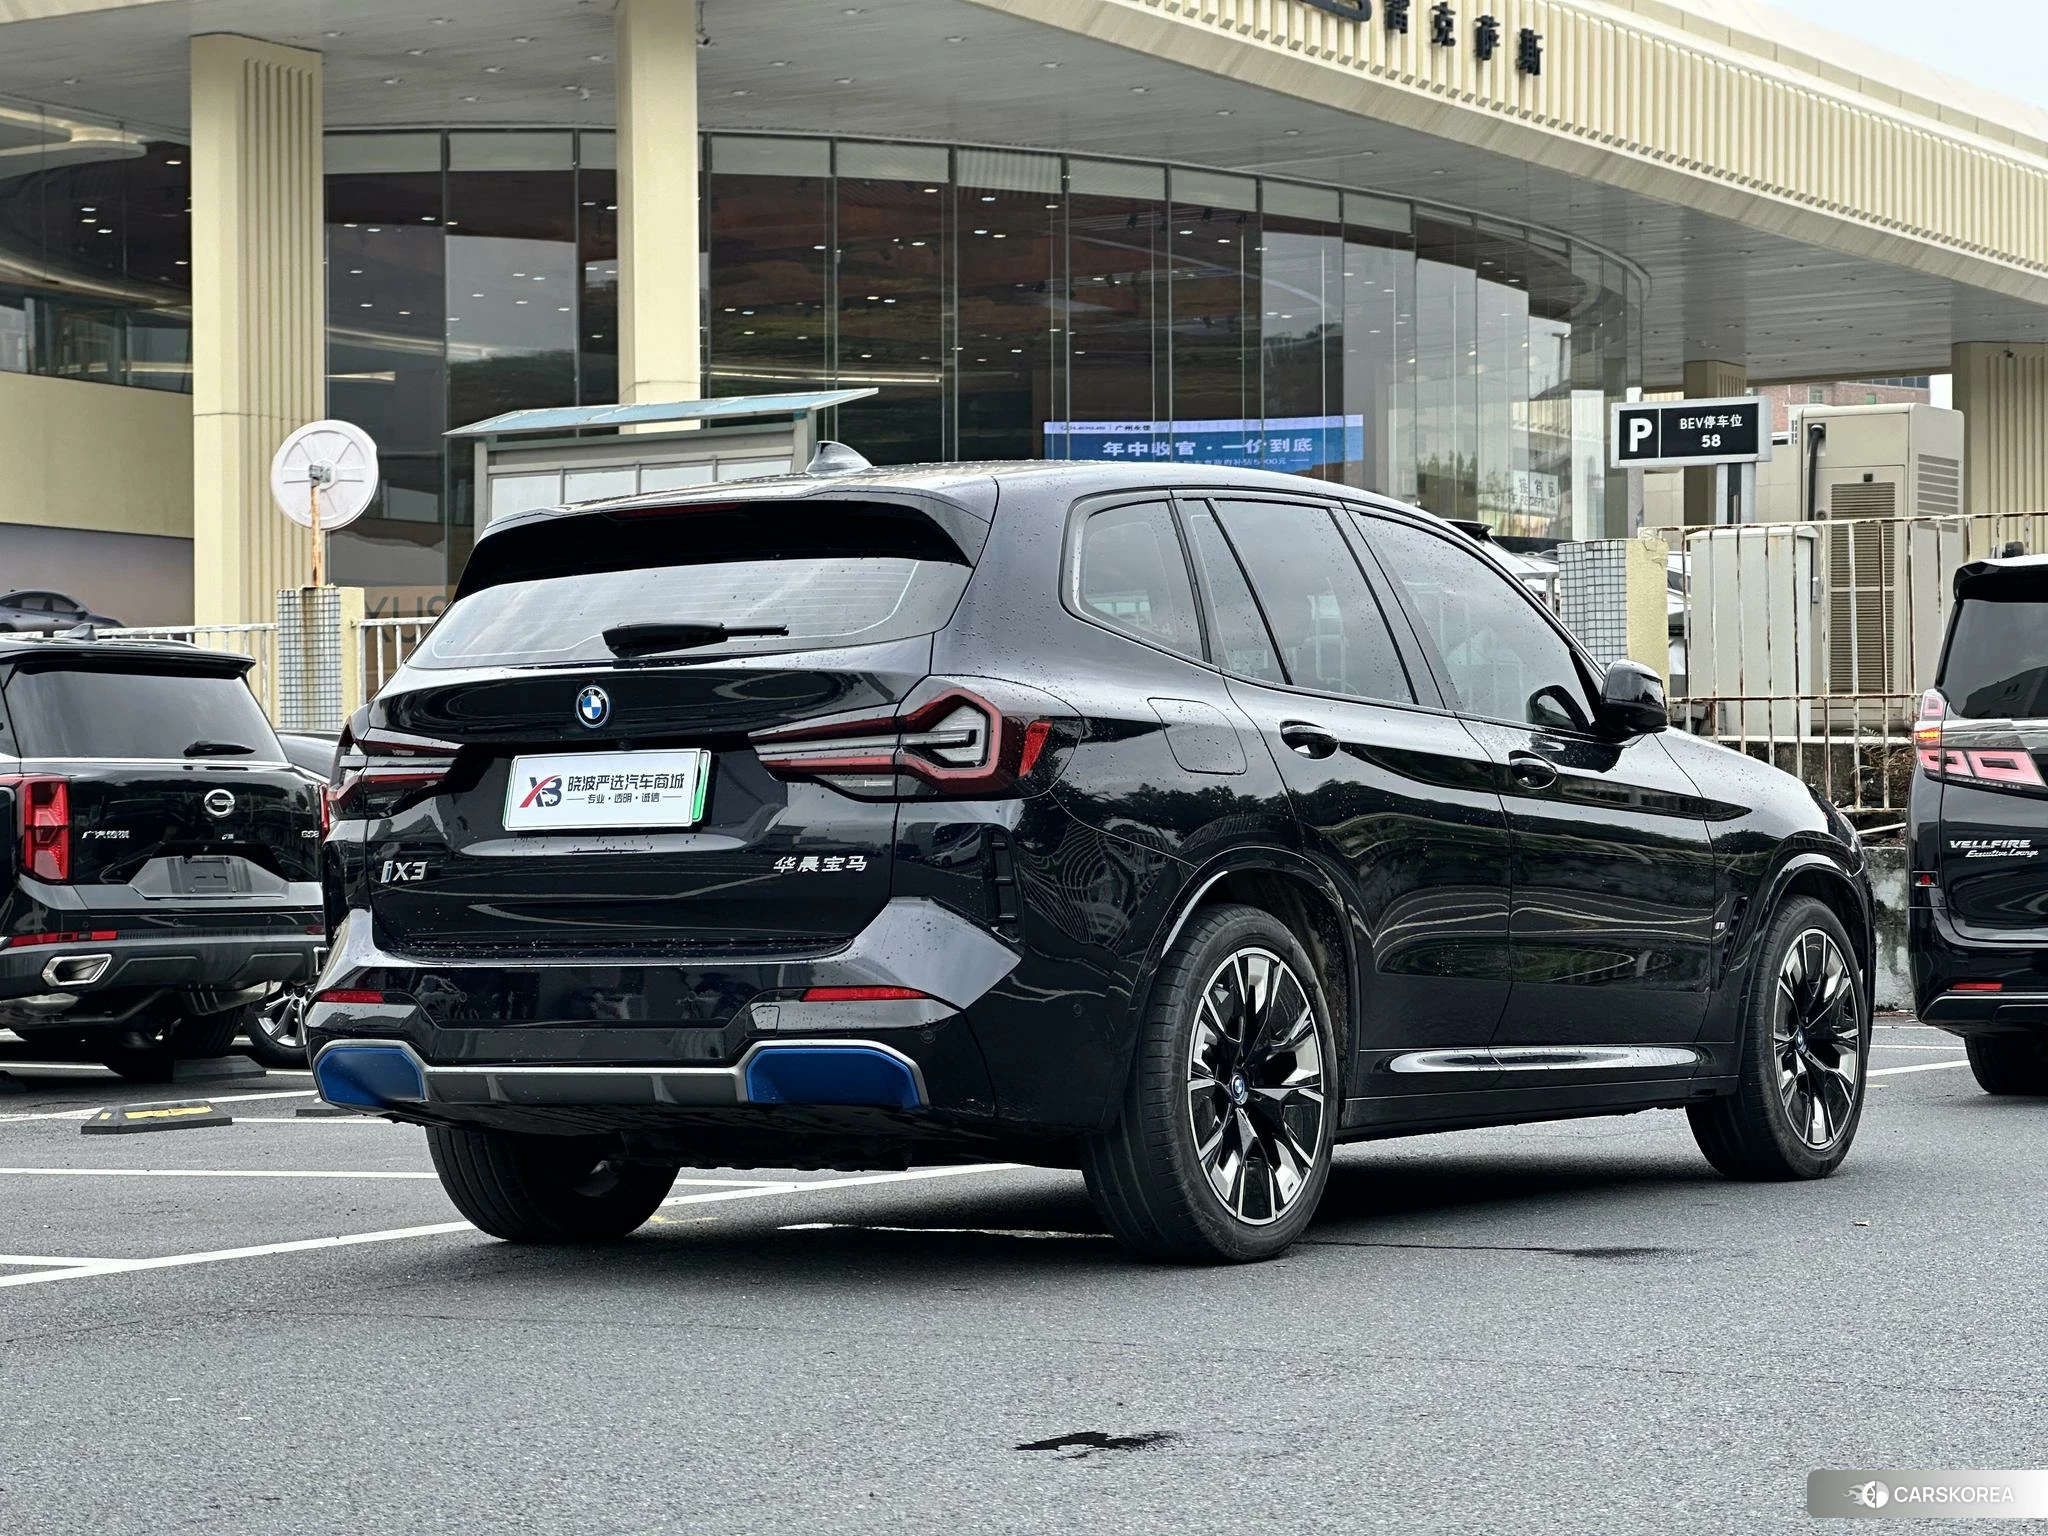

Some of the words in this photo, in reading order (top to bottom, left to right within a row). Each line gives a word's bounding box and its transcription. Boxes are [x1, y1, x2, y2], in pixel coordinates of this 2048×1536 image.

[1679, 414, 1743, 430] BEV停车位
[1629, 418, 1653, 452] P
[1701, 434, 1721, 448] 58
[567, 773, 685, 792] 晓波严选汽车商城
[1949, 839, 2032, 849] VELLFIRE
[1965, 849, 2008, 858] Executive
[2008, 848, 2039, 858] Lounge
[380, 860, 428, 883] iX3
[773, 855, 867, 873] 华晨宝马
